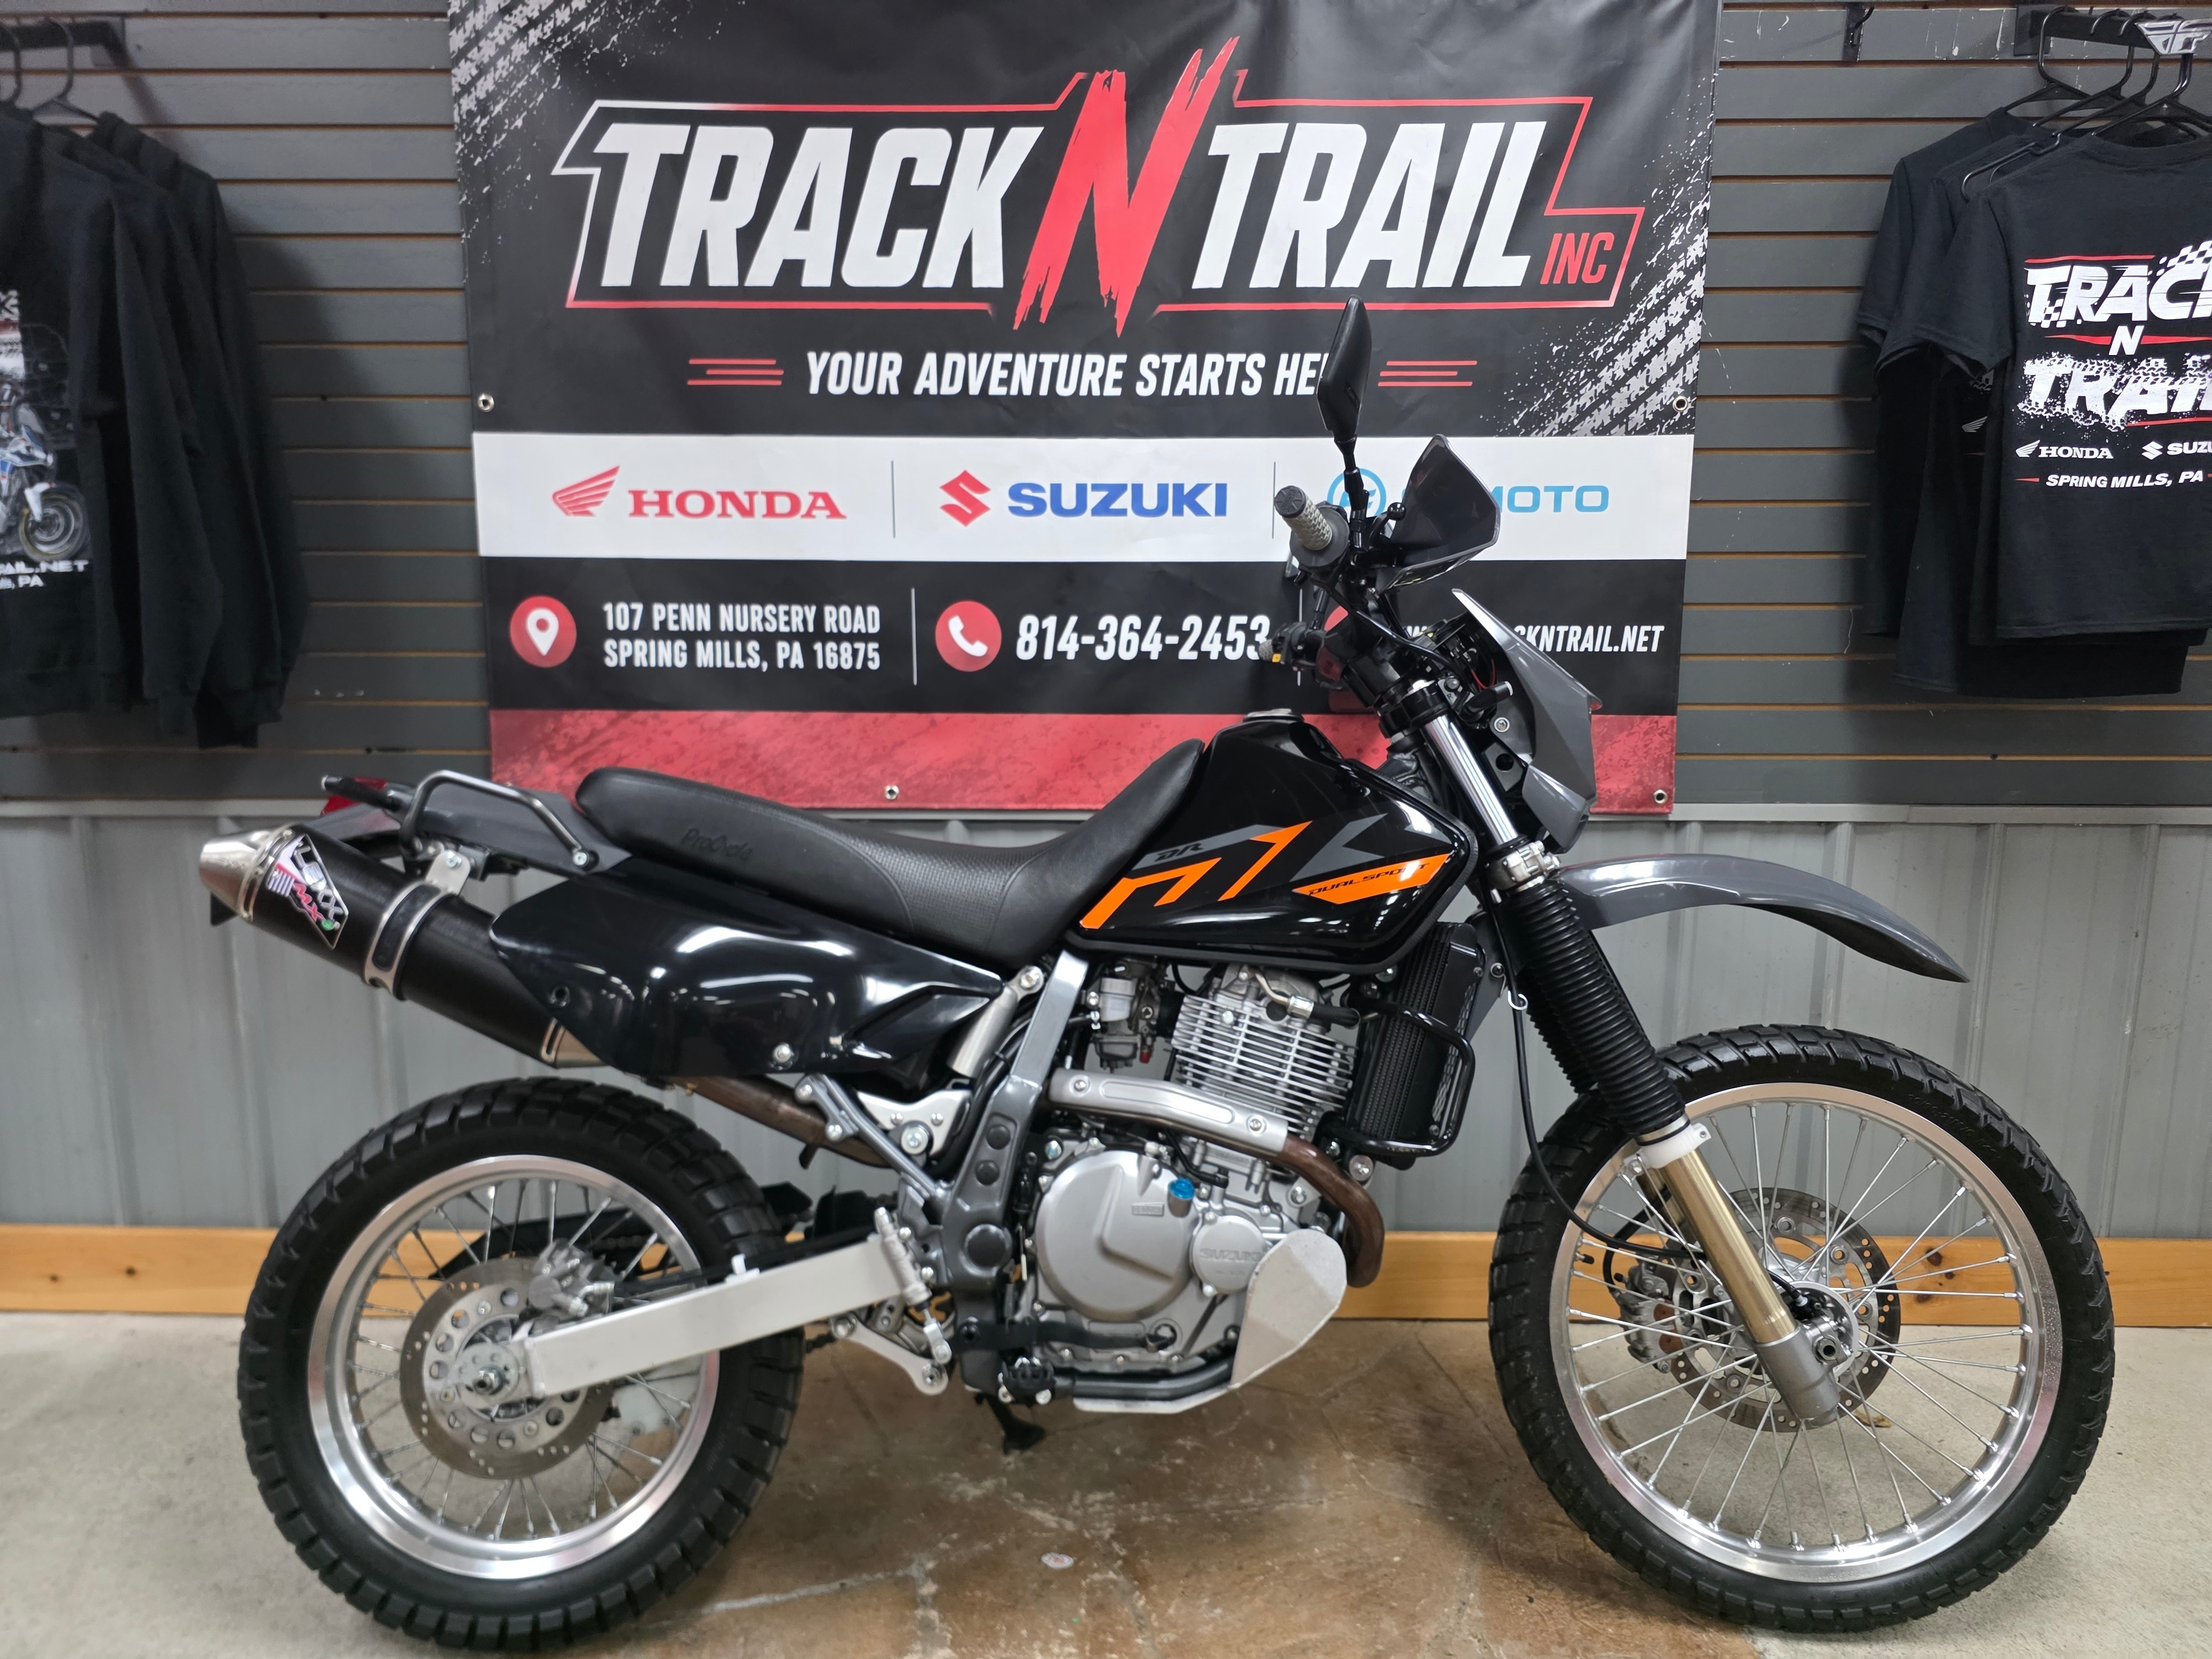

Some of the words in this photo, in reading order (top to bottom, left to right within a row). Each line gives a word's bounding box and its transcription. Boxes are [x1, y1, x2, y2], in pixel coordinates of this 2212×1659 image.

[593, 122, 1044, 288] TRACK
[1014, 35, 1240, 338] N
[1192, 121, 1547, 289] TRAIL
[1540, 232, 1615, 285] INC
[2108, 325, 2145, 356] N
[807, 352, 902, 395] YOUR
[914, 352, 1126, 397] ADVENTURE
[1135, 353, 1265, 397] STARTS
[1274, 353, 1329, 396] HE
[2038, 446, 2114, 459] HONDA
[2046, 474, 2107, 488] SPRING
[2110, 473, 2173, 488] MILLS,
[2178, 470, 2203, 483] PA
[629, 489, 847, 519] HONDA
[1008, 482, 1228, 518] SUZUKI
[18, 574, 44, 588] PA
[603, 601, 643, 631] 107
[652, 602, 711, 632] PENN
[719, 603, 817, 633] NURSERY
[823, 604, 880, 634] ROAD
[1016, 614, 1270, 660] 814-364-2453
[604, 638, 687, 668] SPRING
[696, 640, 768, 672] MILLS,
[776, 640, 804, 669] PA
[813, 641, 880, 670] 16875
[1155, 843, 1204, 862] DR
[1308, 879, 1360, 896] DUAL
[1361, 863, 1430, 882] SPOT
